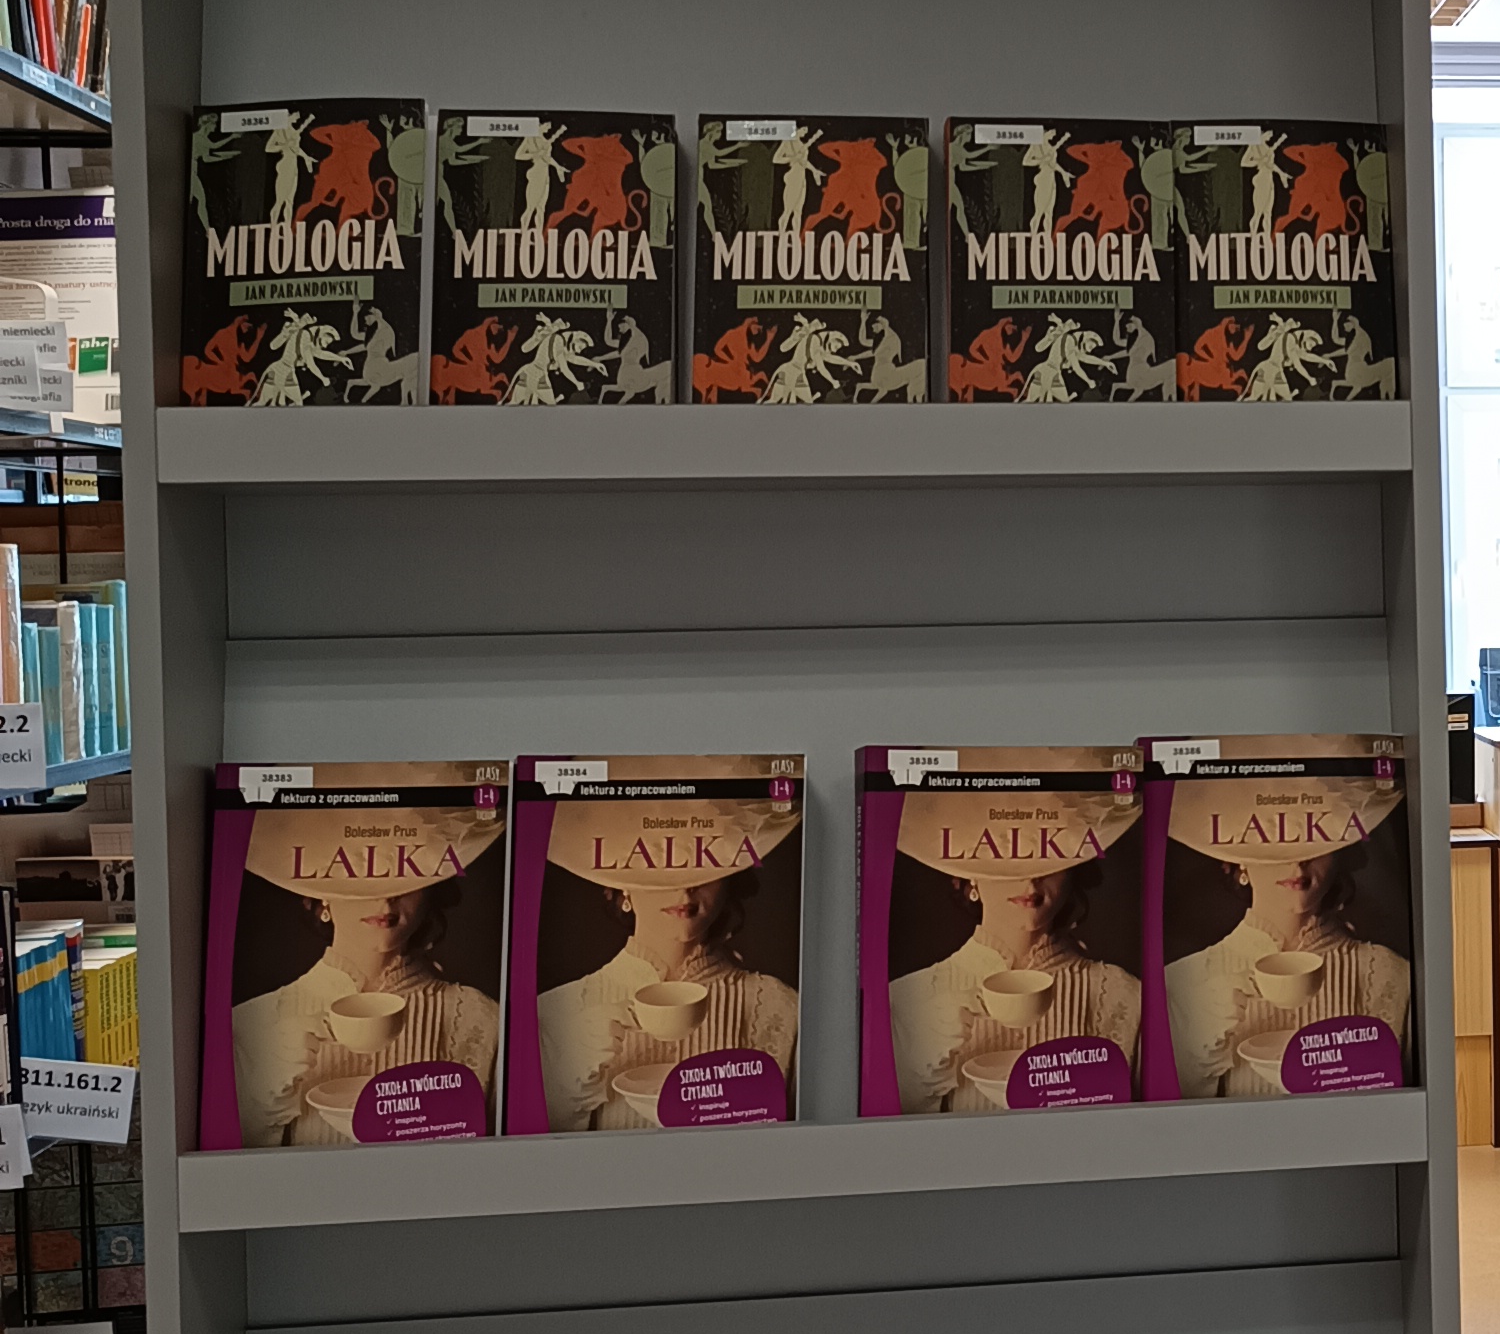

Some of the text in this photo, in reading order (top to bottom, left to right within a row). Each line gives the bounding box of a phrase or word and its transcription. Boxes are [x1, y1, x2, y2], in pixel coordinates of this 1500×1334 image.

[489, 122, 519, 132] 38364
[1215, 131, 1242, 141] 38367
[35, 215, 70, 230] droga
[74, 214, 91, 227] do
[206, 218, 405, 277] MITOLOGIA
[454, 228, 658, 281] MITOLOGIA
[713, 230, 911, 282] MITOLOGIA
[967, 231, 1160, 282] MITOLOGIA
[1189, 232, 1377, 283] MITOLOGIA
[245, 280, 359, 301] JAN PARANDOWSKI
[495, 289, 613, 305] JAN PARANDOWSKI
[753, 290, 867, 305] JAN PARANDOWSKI
[1008, 290, 1119, 305] JAN PARANDOWSKI
[1229, 290, 1338, 305] JAN PARANDOWSKI
[2, 326, 55, 336] niemiecki
[262, 774, 292, 783] 38383
[476, 766, 500, 782] KLASY
[557, 768, 587, 777] 38384
[281, 792, 399, 805] lektura z opracowaniem
[581, 784, 696, 797] lektura z opracowaniem
[1256, 793, 1323, 806] Bolesław Prus
[643, 817, 714, 829] Bolesław Prus
[1209, 810, 1370, 845] LALKA
[345, 825, 417, 838] Bolesław Prus
[940, 827, 1106, 860] LALKA
[591, 835, 764, 870] LALKA
[291, 844, 466, 880] LALKA
[21, 1067, 122, 1093] 811.161.2
[375, 1073, 461, 1098] SZKOŁA TWÓRCZEGO
[57, 1102, 119, 1119] ukraiński
[376, 1096, 421, 1116] CZYTANIA
